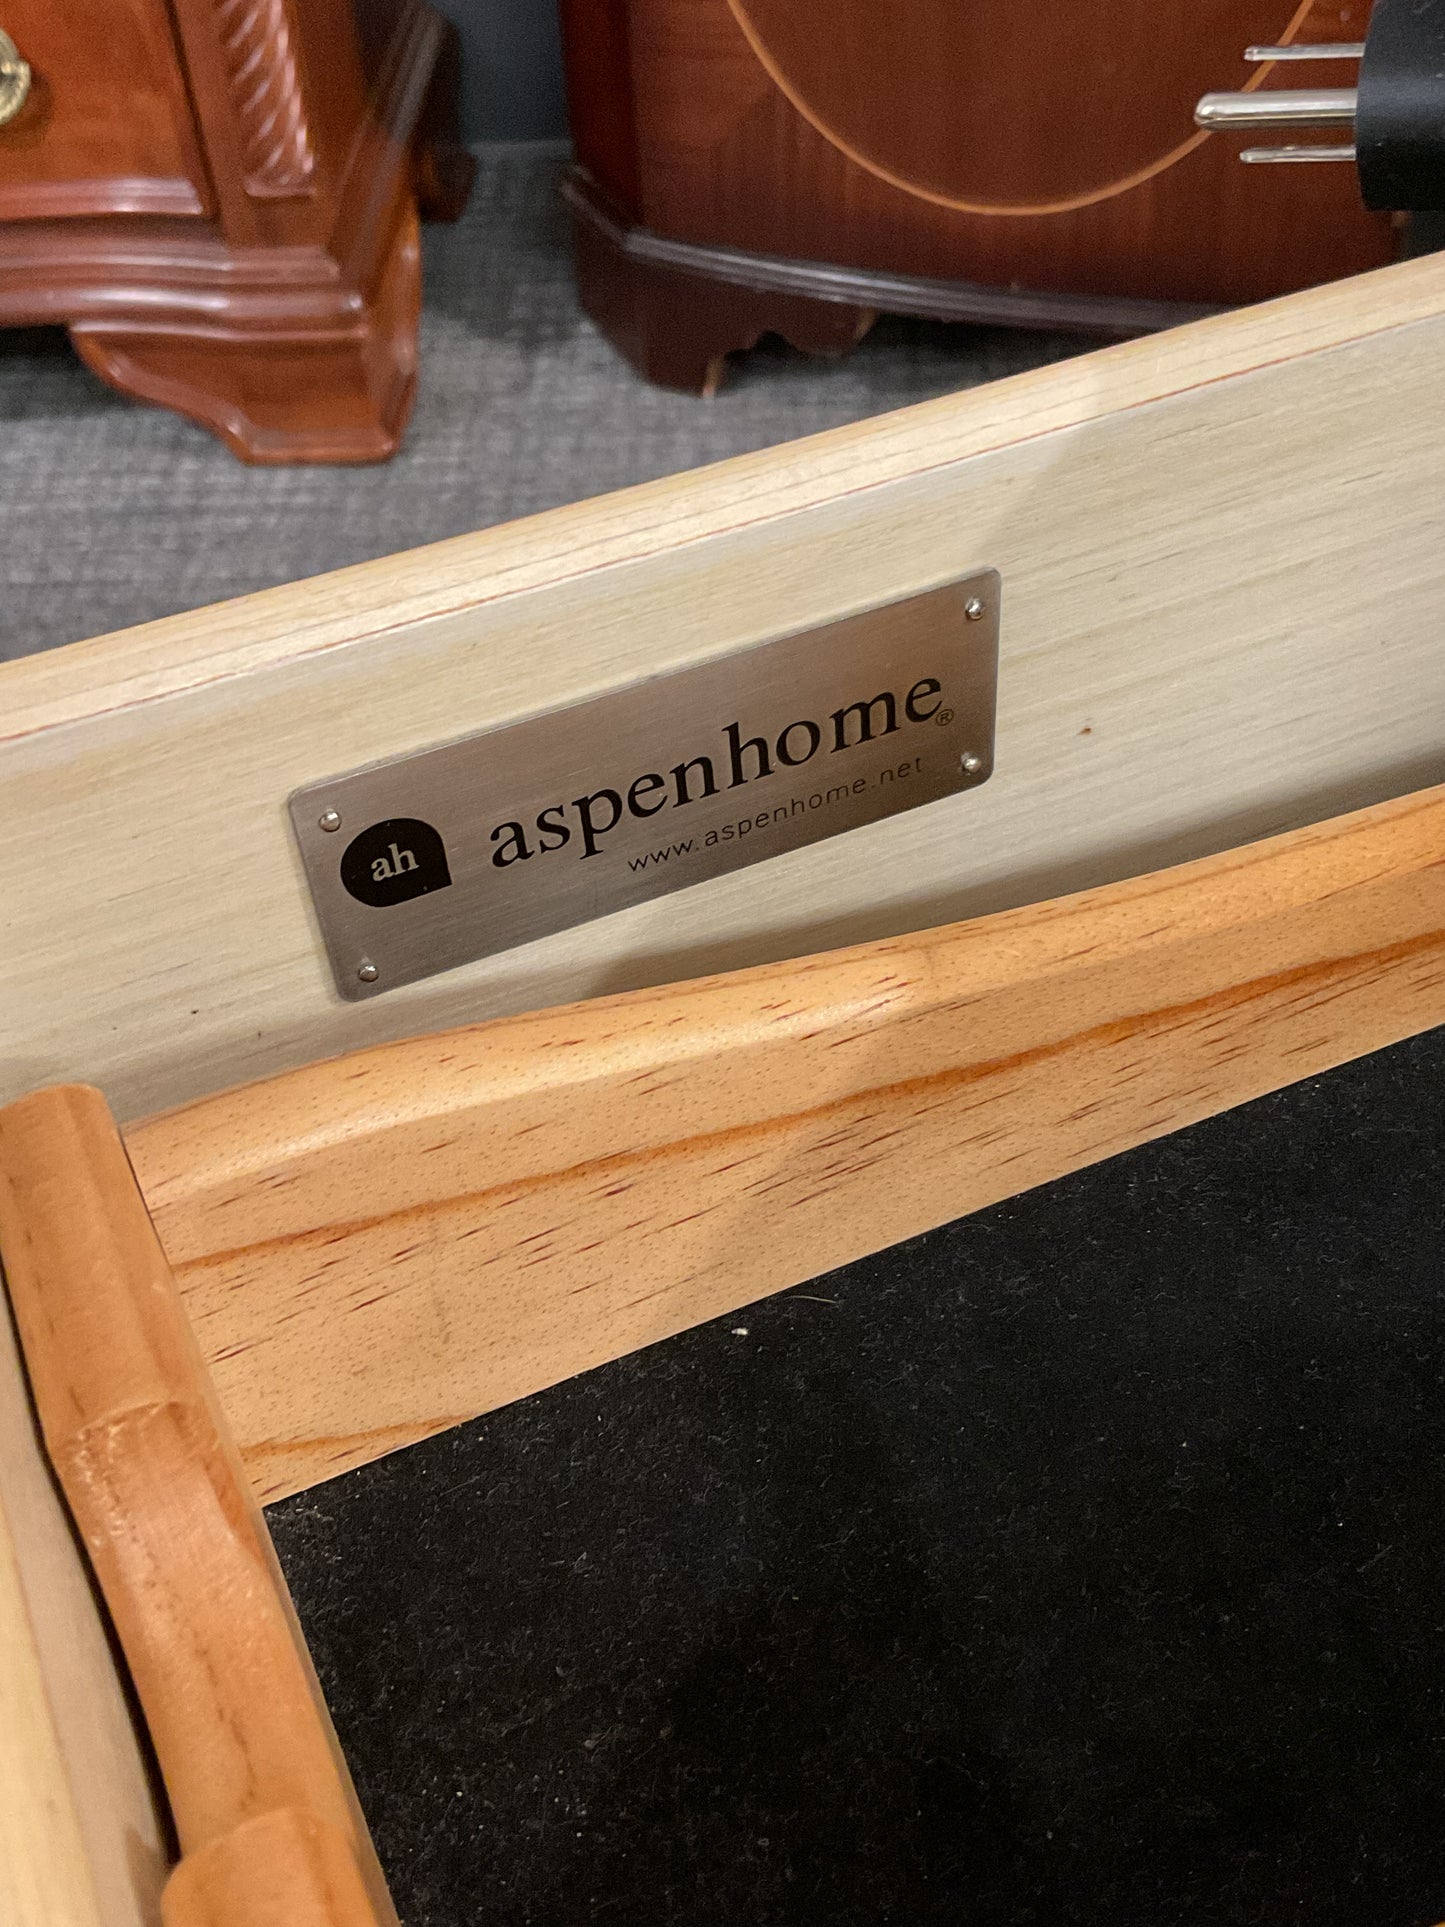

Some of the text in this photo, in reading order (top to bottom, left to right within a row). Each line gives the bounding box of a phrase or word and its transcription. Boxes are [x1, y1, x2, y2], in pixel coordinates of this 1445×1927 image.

[489, 676, 943, 869] aspenhome
[627, 756, 923, 872] www.aspenhome.net
[370, 842, 420, 882] ah
